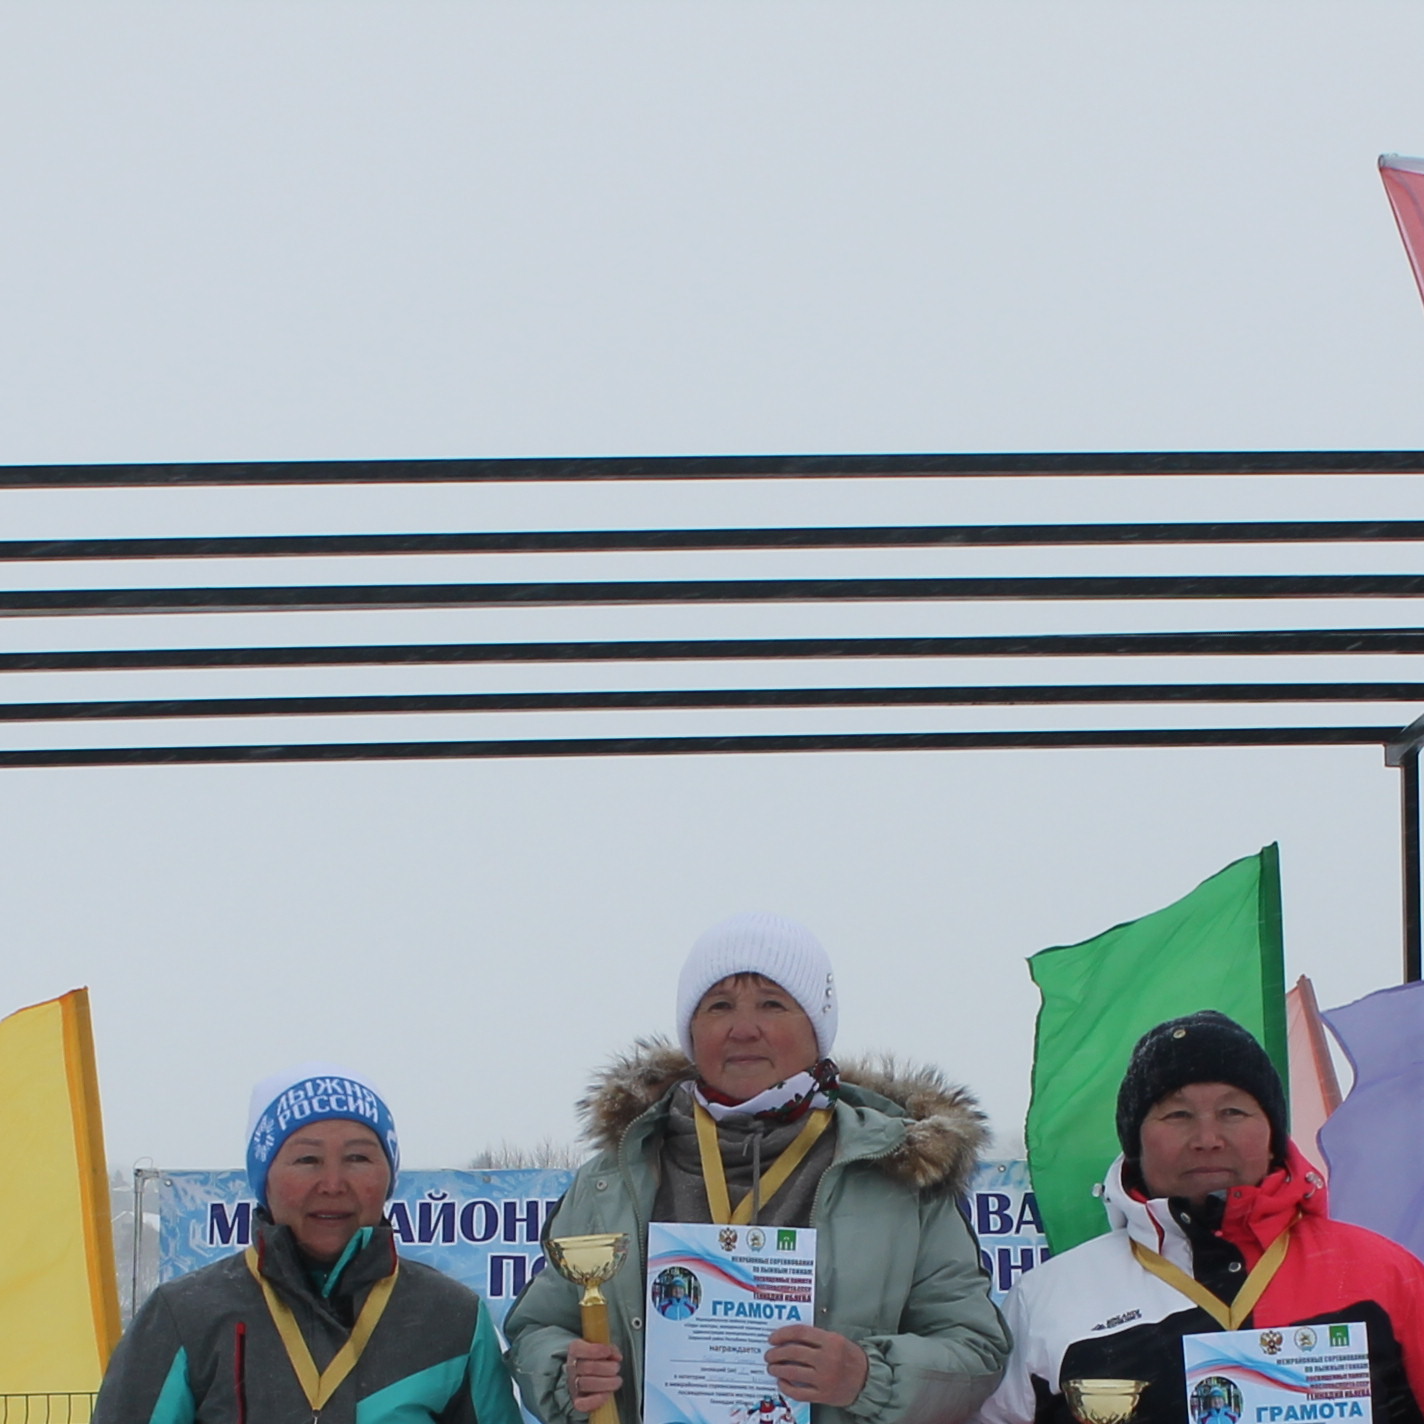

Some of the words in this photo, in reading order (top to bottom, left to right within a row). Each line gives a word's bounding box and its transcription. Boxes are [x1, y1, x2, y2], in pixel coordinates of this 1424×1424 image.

[276, 1078, 377, 1116] ЛЫЖНЯ
[277, 1094, 379, 1131] РОССИИ
[712, 1300, 802, 1321] ГРАМОТА
[1256, 1401, 1364, 1423] ГРАМОТА
